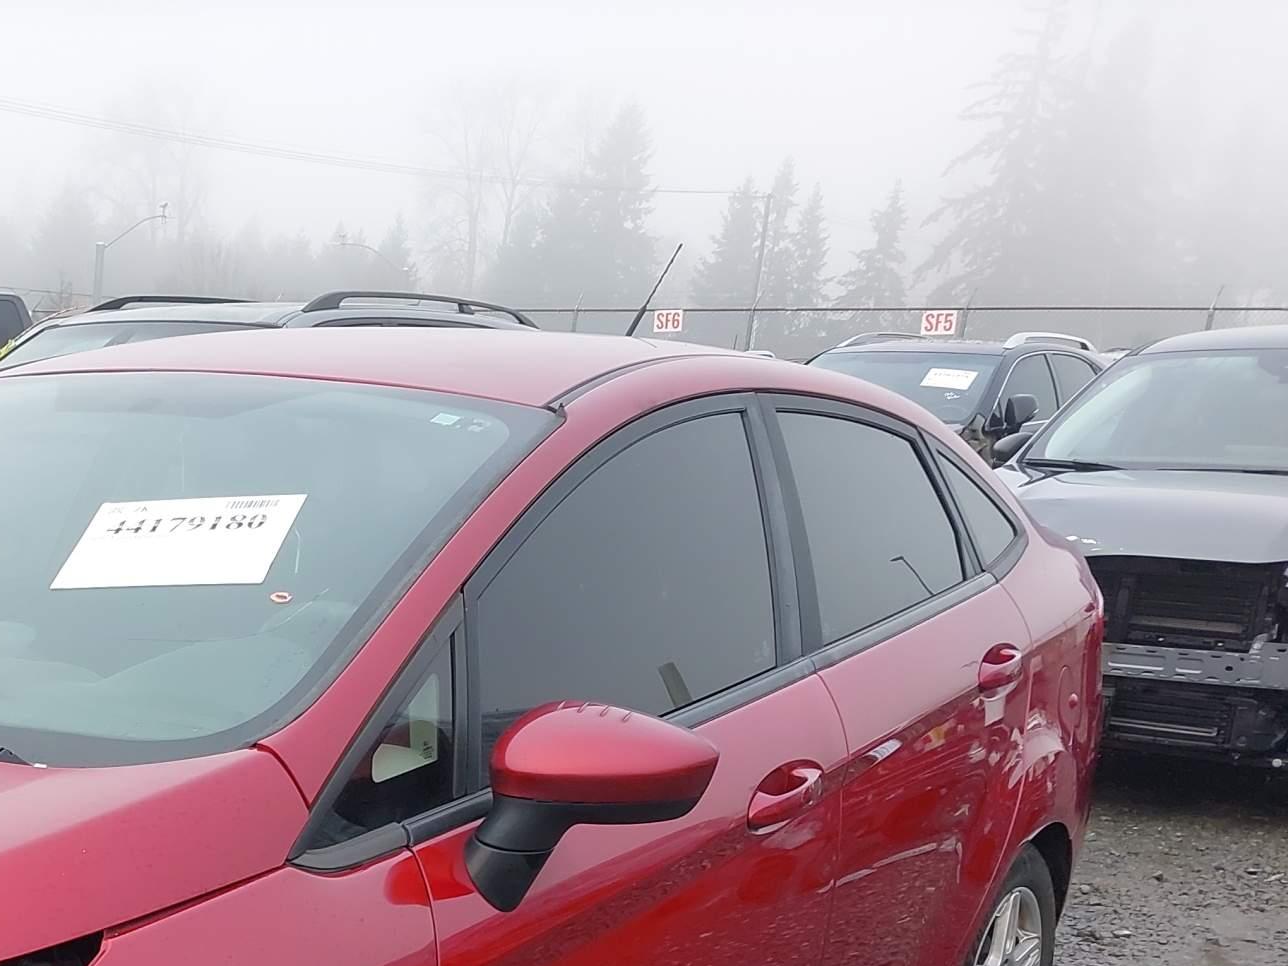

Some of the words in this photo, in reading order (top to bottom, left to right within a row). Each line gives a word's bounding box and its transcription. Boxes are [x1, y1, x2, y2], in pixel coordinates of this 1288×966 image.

[656, 312, 681, 330] SF6
[924, 313, 955, 332] SF5
[107, 514, 268, 535] 44179180
